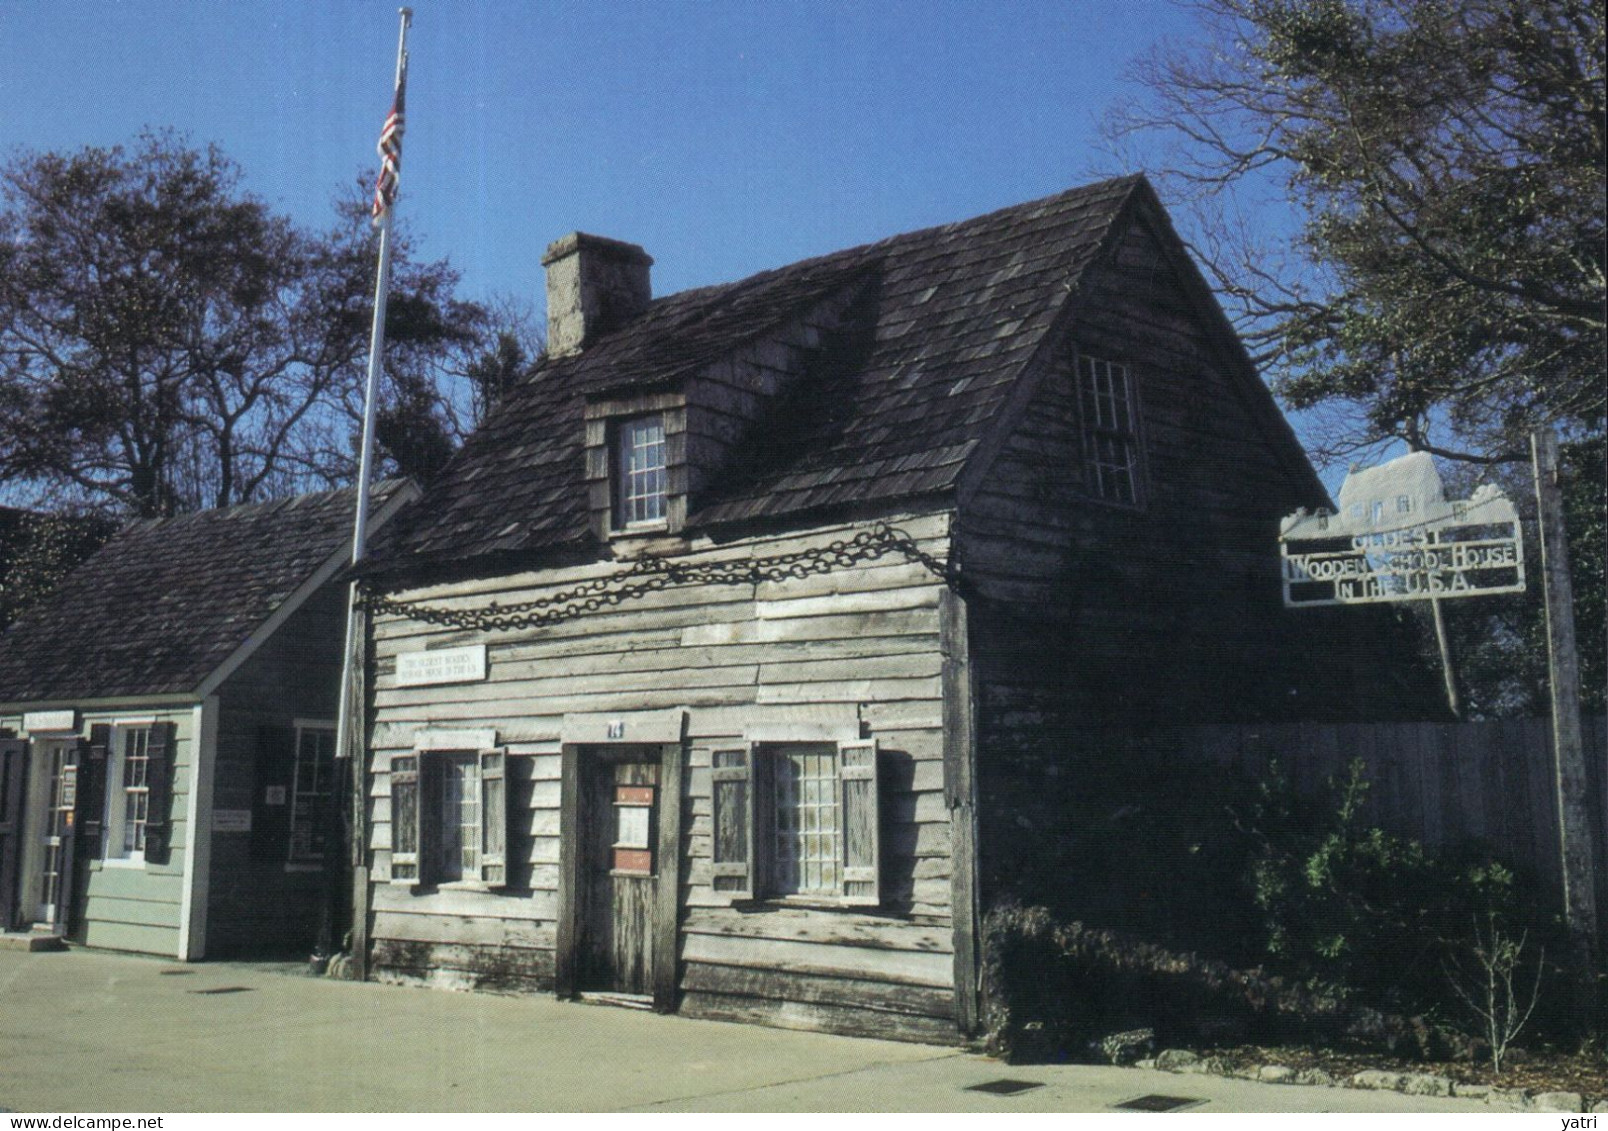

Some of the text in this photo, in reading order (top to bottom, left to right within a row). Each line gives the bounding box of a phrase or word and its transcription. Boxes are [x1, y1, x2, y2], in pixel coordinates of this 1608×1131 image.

[1352, 525, 1443, 550] OLDEST
[1289, 555, 1367, 579] WOODEN
[1451, 543, 1515, 571] HOUSE
[1336, 570, 1476, 599] IN THE U.S.A.
